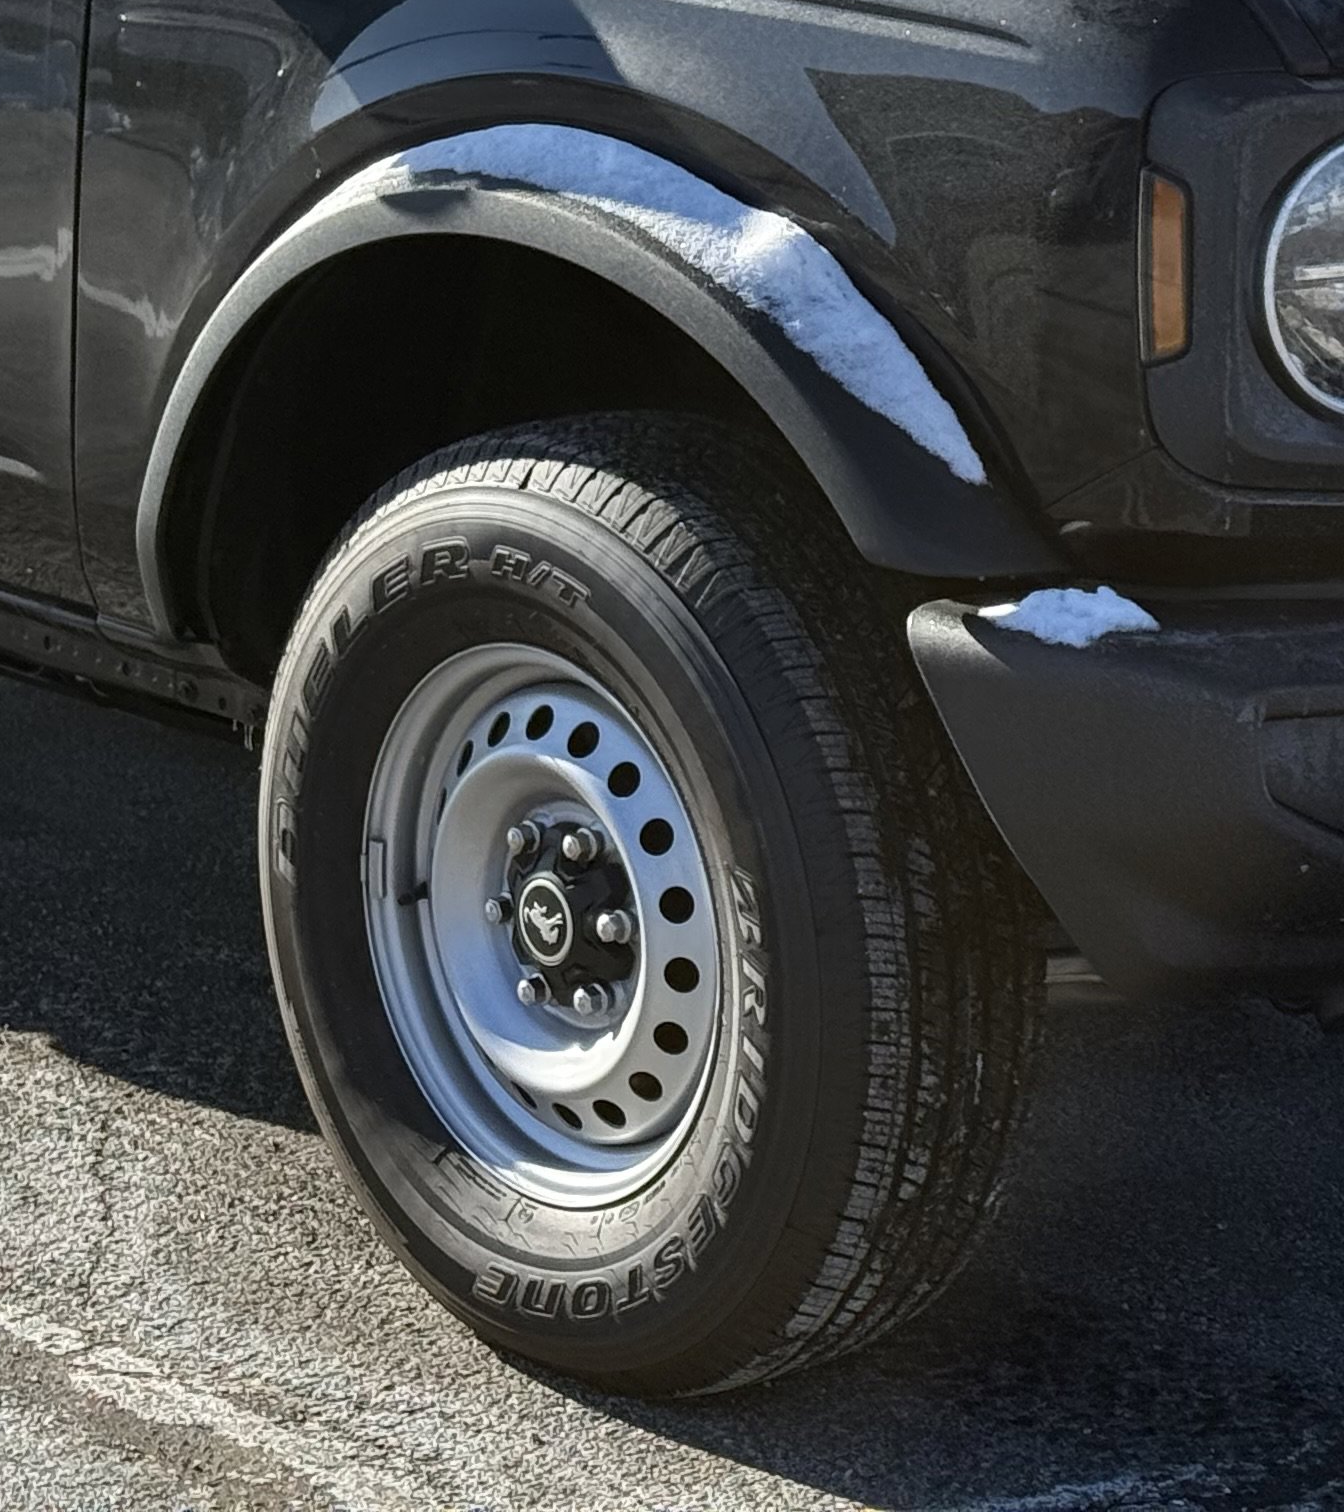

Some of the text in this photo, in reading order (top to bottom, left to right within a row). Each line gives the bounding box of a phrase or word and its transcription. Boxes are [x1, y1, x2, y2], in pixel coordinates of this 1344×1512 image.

[275, 535, 592, 886] DUELER H/T
[471, 864, 768, 1320] BRIDGESTONE
